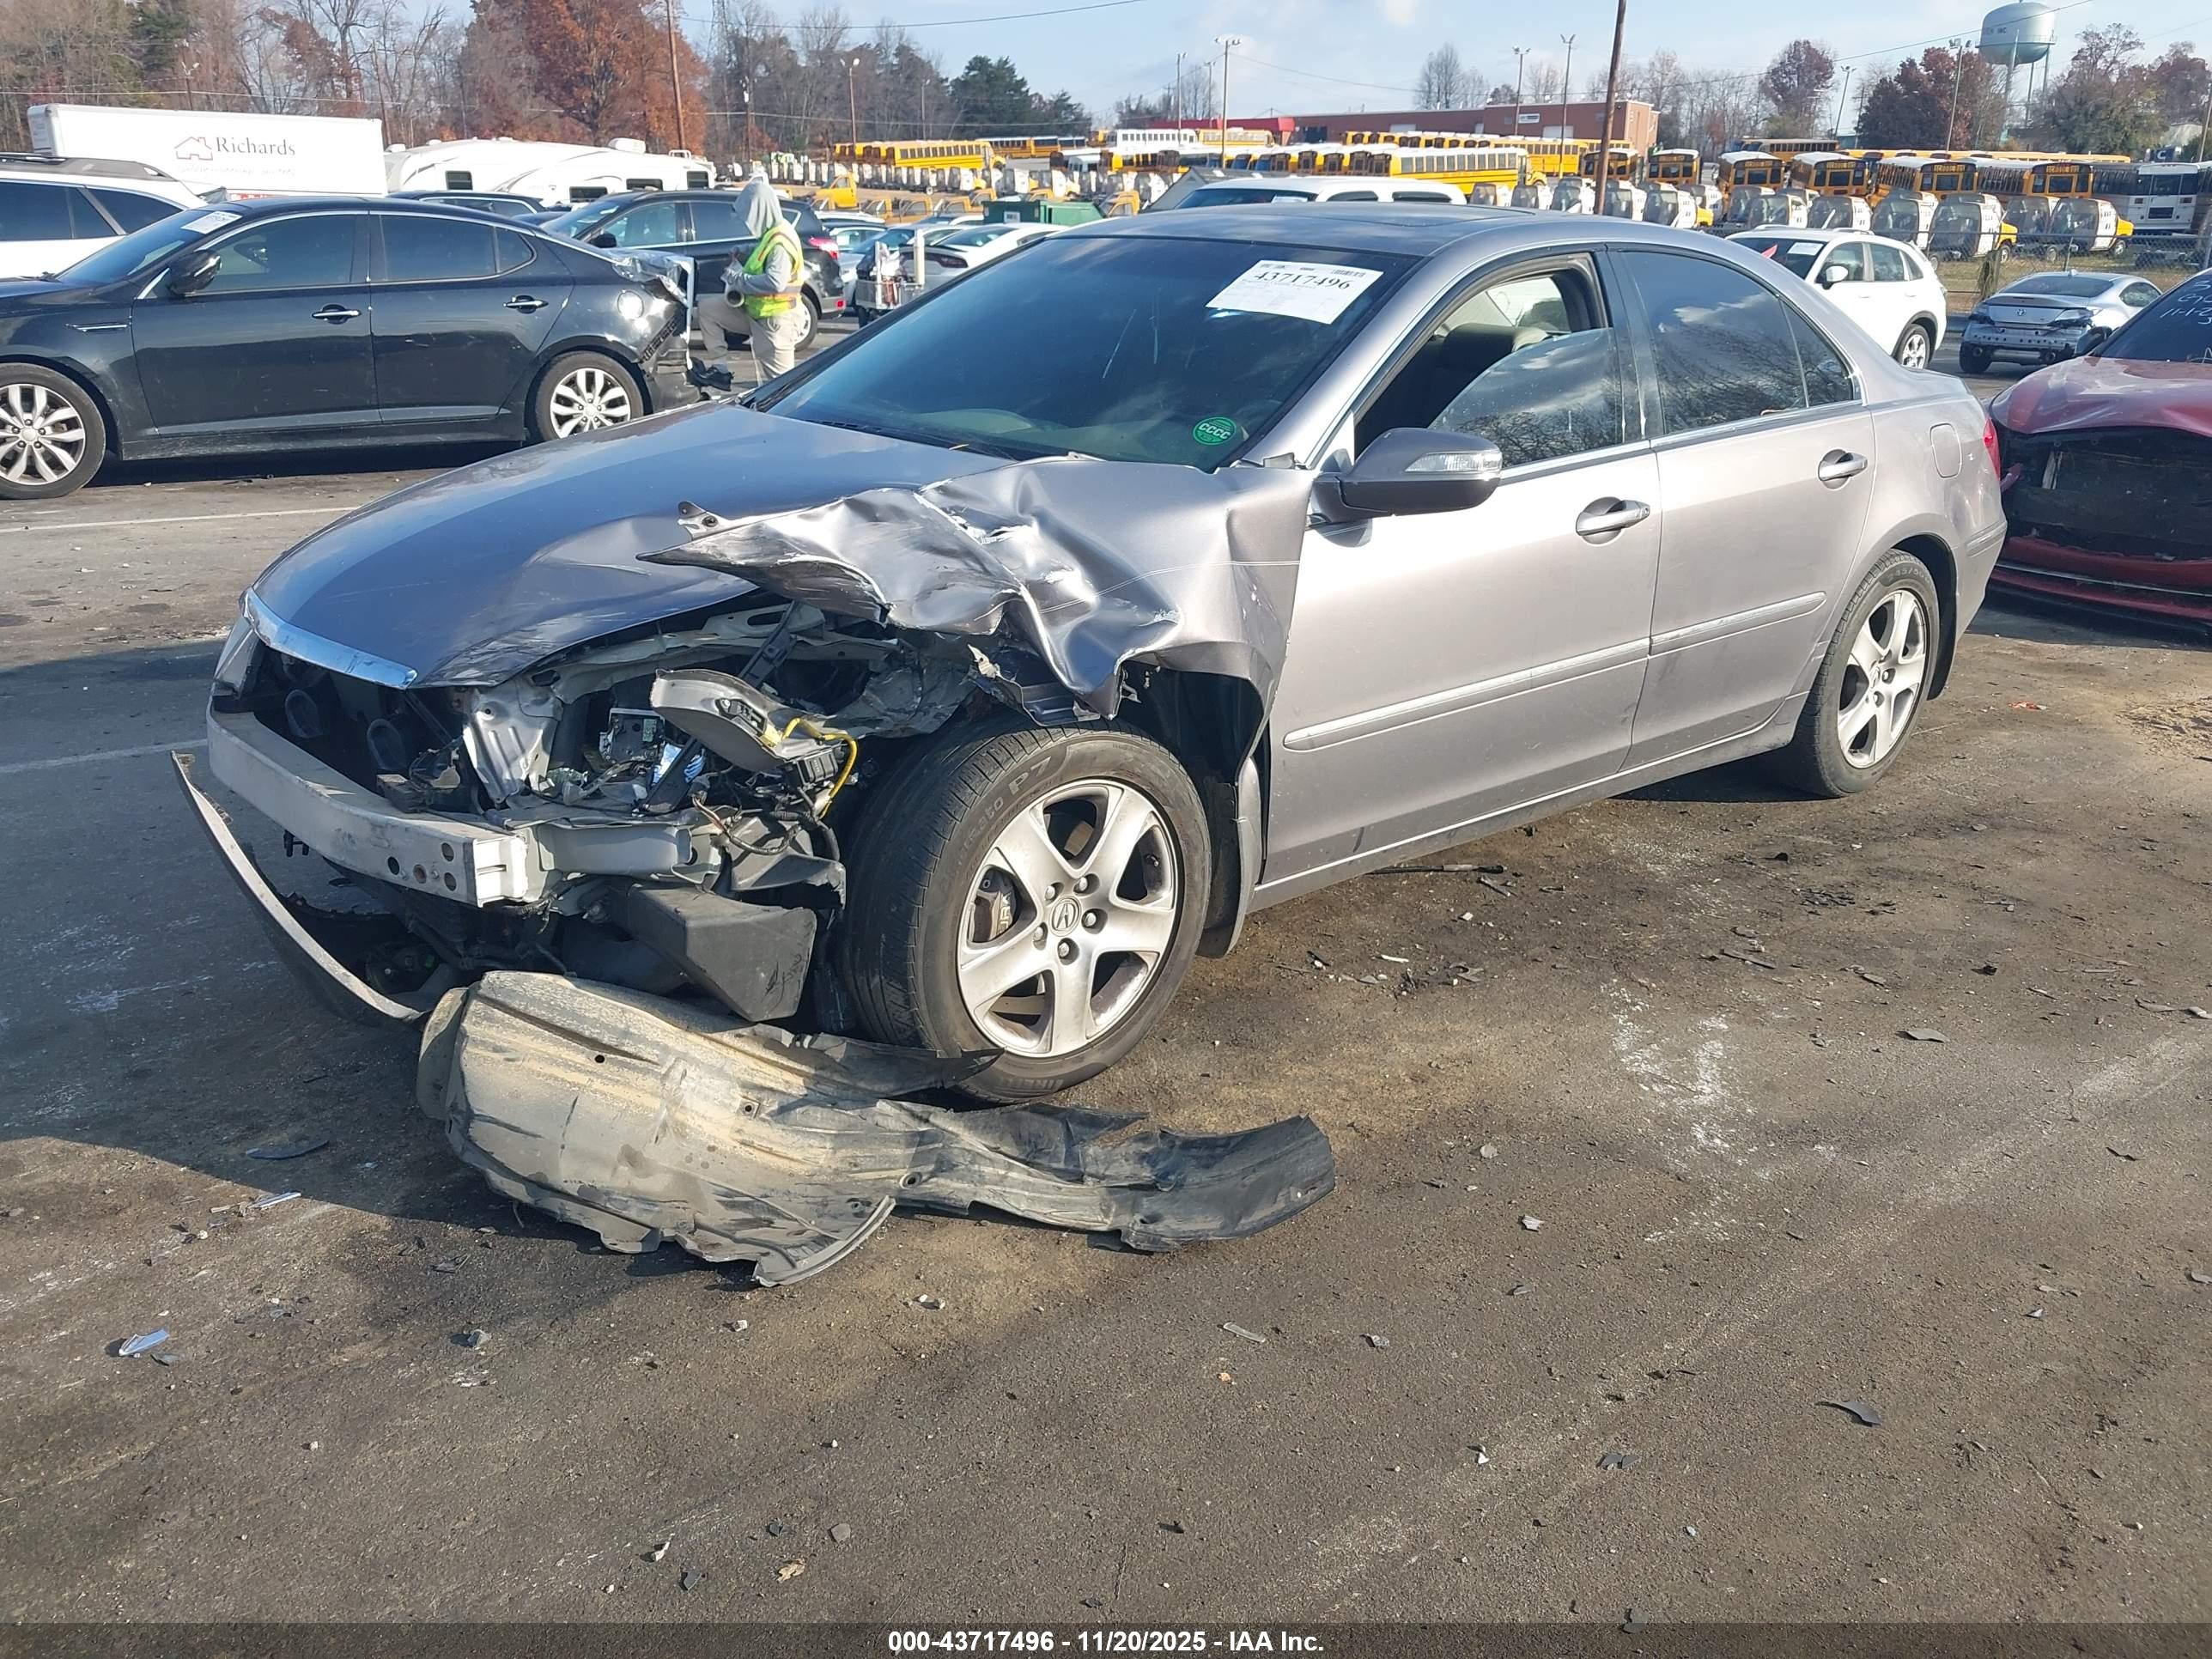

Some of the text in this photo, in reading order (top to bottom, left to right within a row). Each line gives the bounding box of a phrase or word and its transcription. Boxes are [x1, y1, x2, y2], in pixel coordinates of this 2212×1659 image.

[216, 137, 295, 156] Richards
[1254, 270, 1355, 290] 43717496
[1008, 757, 1052, 796] P7
